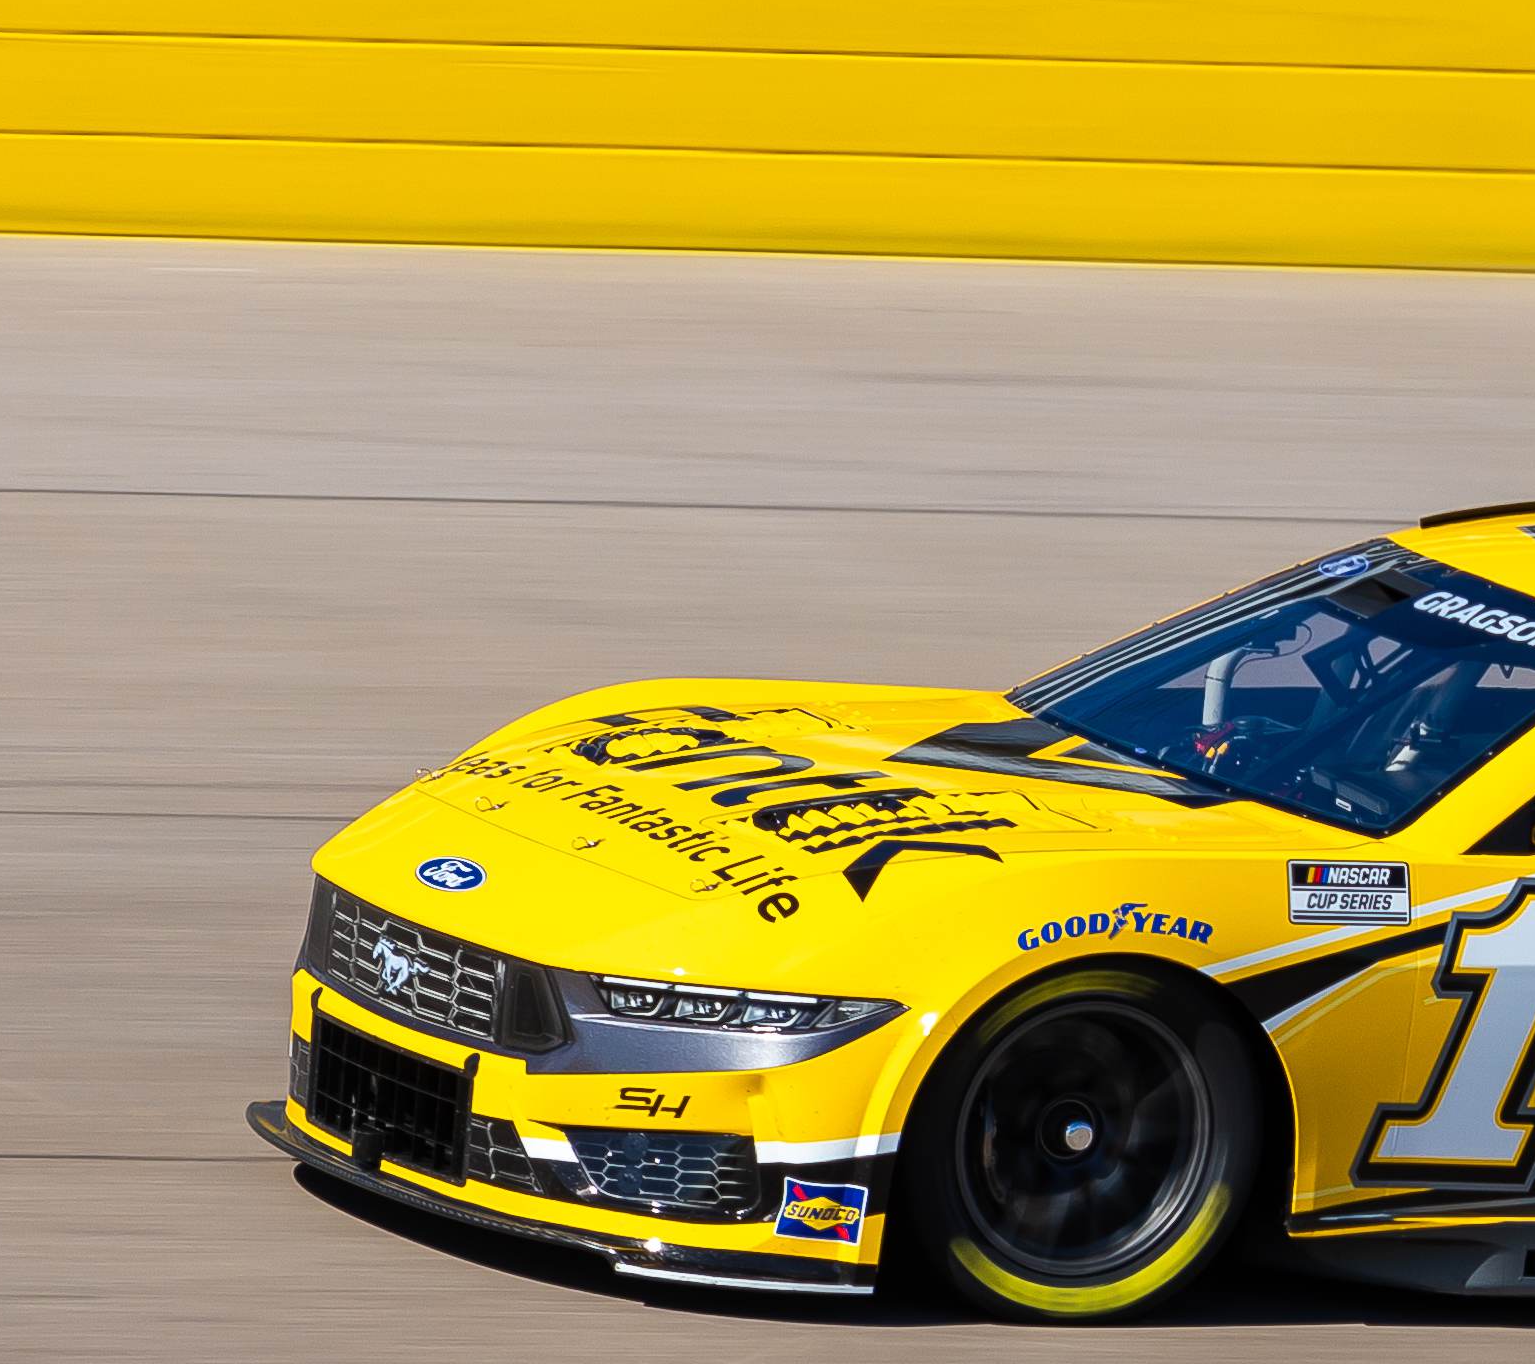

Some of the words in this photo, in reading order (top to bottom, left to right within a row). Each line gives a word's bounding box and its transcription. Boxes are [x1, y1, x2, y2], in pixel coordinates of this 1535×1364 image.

[508, 767, 583, 794] for
[561, 784, 731, 862] Fantastic
[711, 854, 800, 923] Life
[422, 860, 476, 888] Ford
[1326, 866, 1391, 886] NASCAR
[1306, 892, 1338, 910] CUP
[1339, 893, 1393, 911] SERIES
[789, 1203, 857, 1222] SUNOCO
